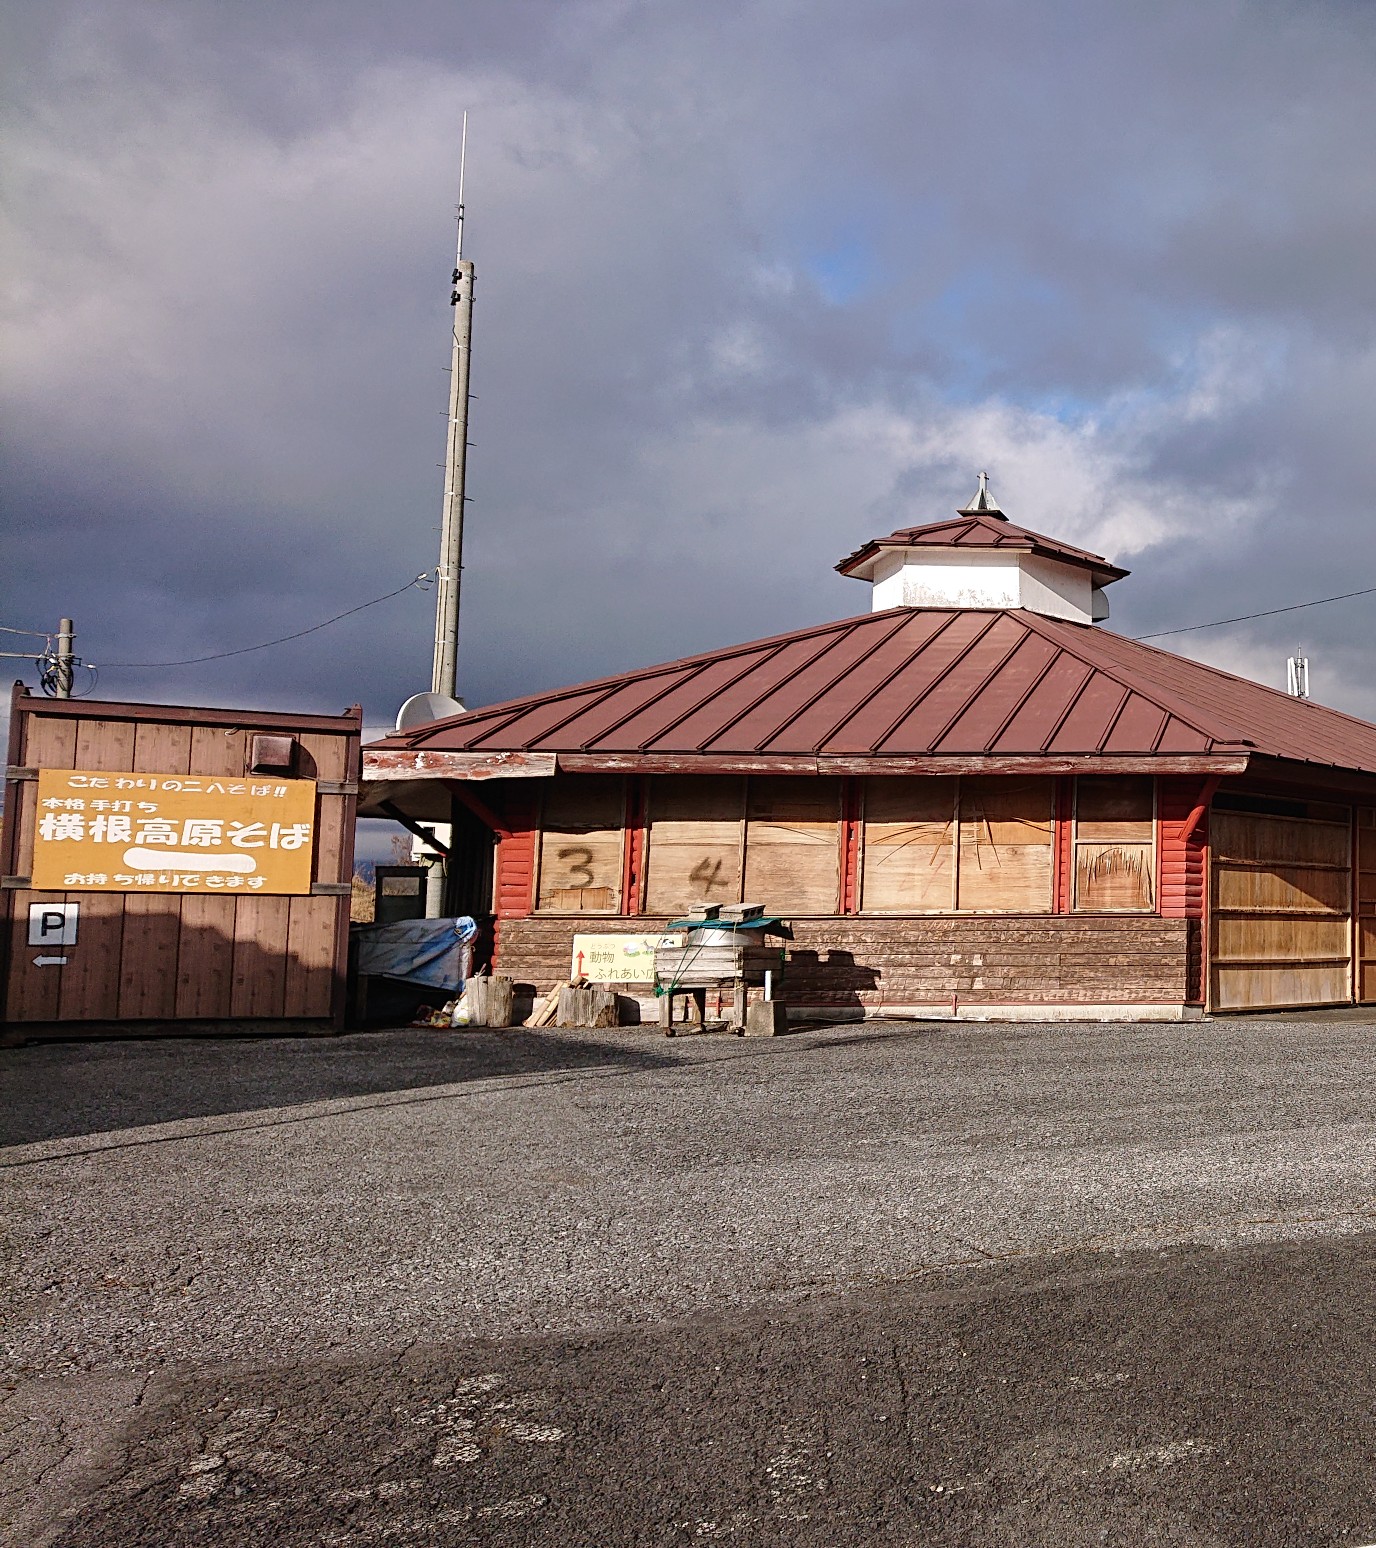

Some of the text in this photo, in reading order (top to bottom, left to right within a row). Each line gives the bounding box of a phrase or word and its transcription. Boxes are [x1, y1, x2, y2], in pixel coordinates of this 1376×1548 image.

[41, 797, 159, 814] 本格手打ち
[38, 812, 311, 851] 横根高原そば
[63, 872, 268, 889] お持ち帰りできます
[557, 847, 595, 890] 3
[688, 856, 729, 895] 4
[41, 911, 66, 936] P
[589, 951, 615, 964] 動物
